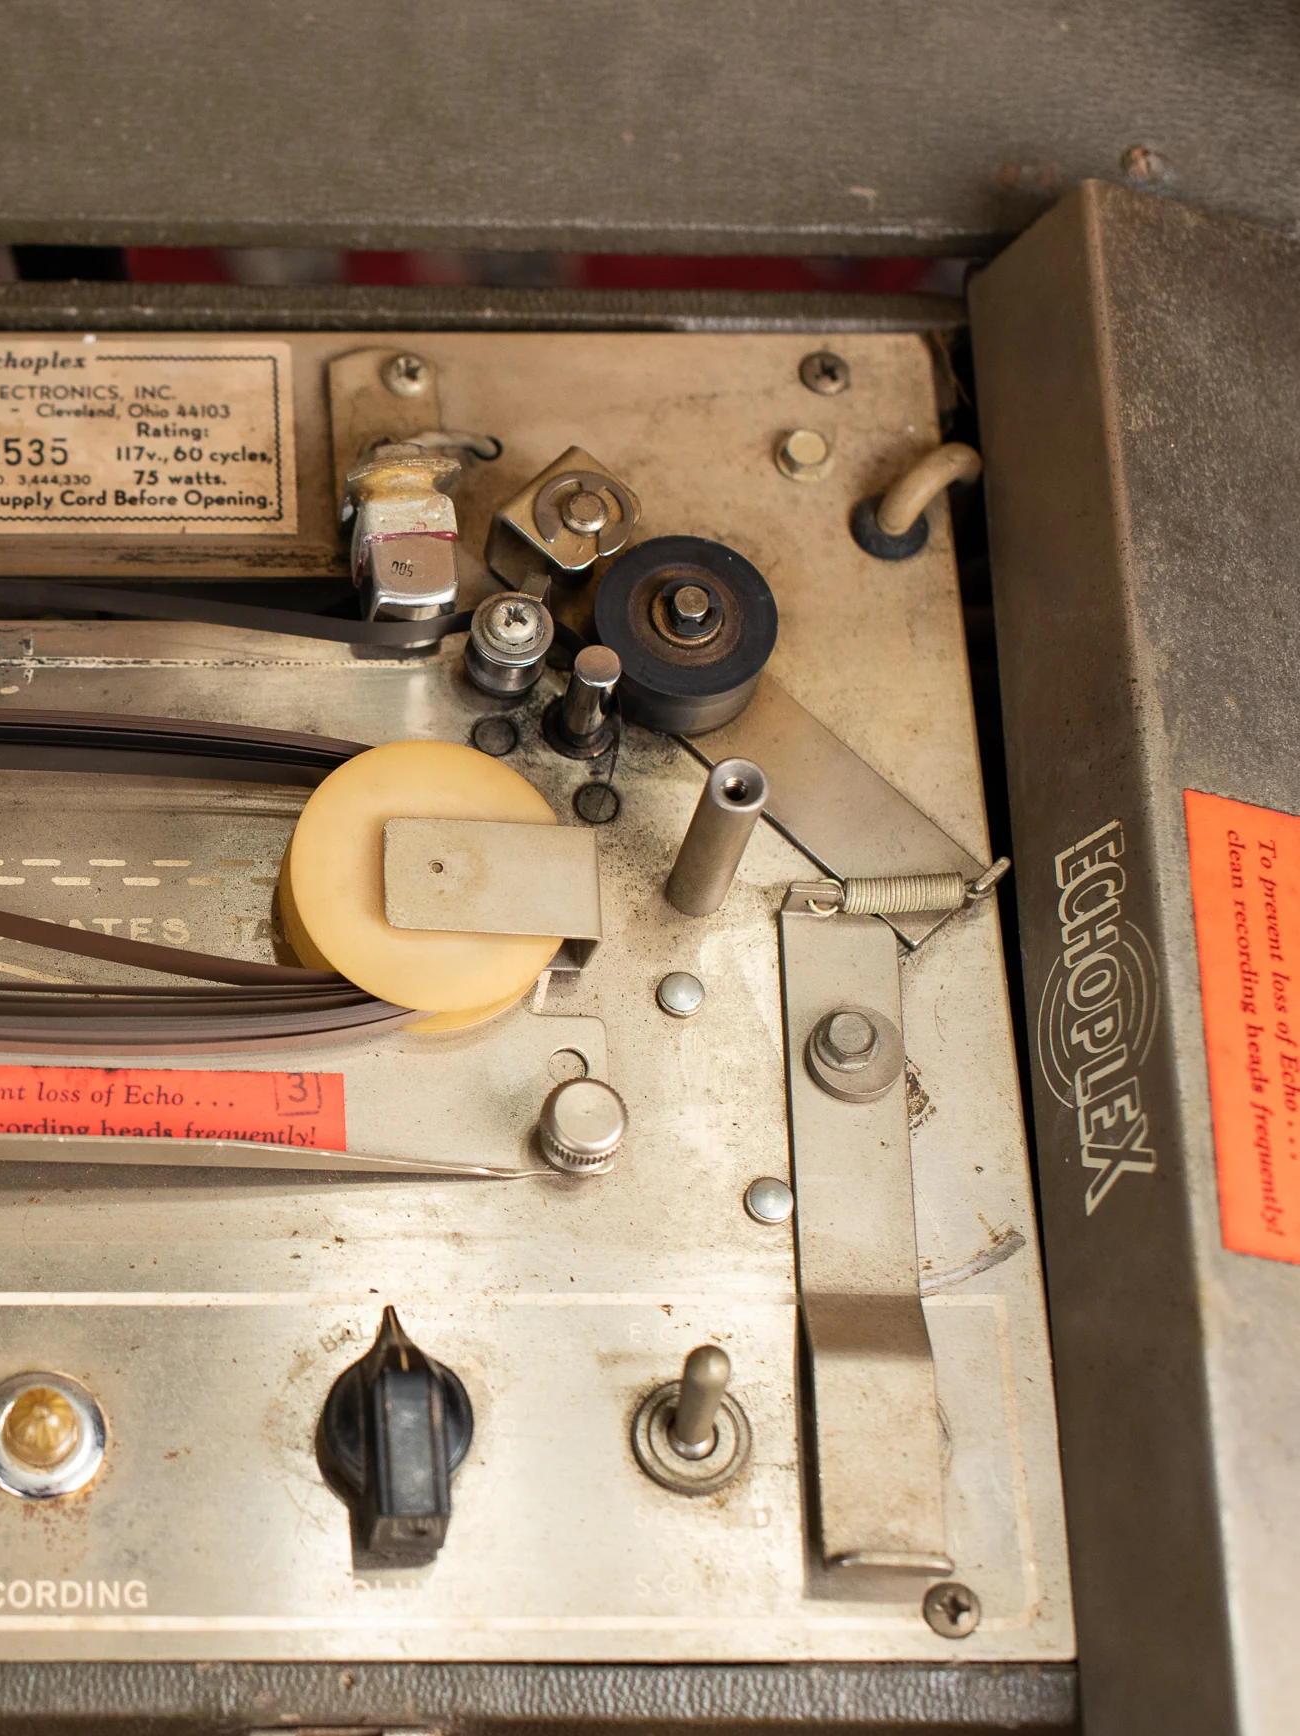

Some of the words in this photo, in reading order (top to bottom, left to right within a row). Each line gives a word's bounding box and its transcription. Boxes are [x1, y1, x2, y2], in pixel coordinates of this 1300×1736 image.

[135, 385, 177, 400] INC.
[36, 403, 121, 420] Cleveland,
[128, 403, 170, 418] Ohio
[176, 404, 231, 418] 44103
[137, 422, 209, 441] Rating:
[173, 446, 203, 462] 60
[210, 446, 273, 465] cycles,
[18, 475, 91, 488] 3,444,330
[134, 470, 159, 485] 75
[168, 471, 227, 485] watts.
[60, 490, 107, 507] Cord
[114, 489, 178, 507] Before
[184, 490, 275, 509] Opening.
[1227, 829, 1247, 889] clean
[1258, 839, 1278, 870] To
[1259, 877, 1285, 962] prevent
[1234, 899, 1260, 1015] recording
[1272, 972, 1291, 1014] loss
[1055, 819, 1157, 1217] ECHOPLEX
[1275, 1021, 1298, 1048] of
[1246, 1023, 1269, 1093] heads
[38, 1081, 81, 1103] loss
[91, 1083, 115, 1107] of
[124, 1085, 184, 1107] Echo
[1250, 1102, 1286, 1237] frequently!
